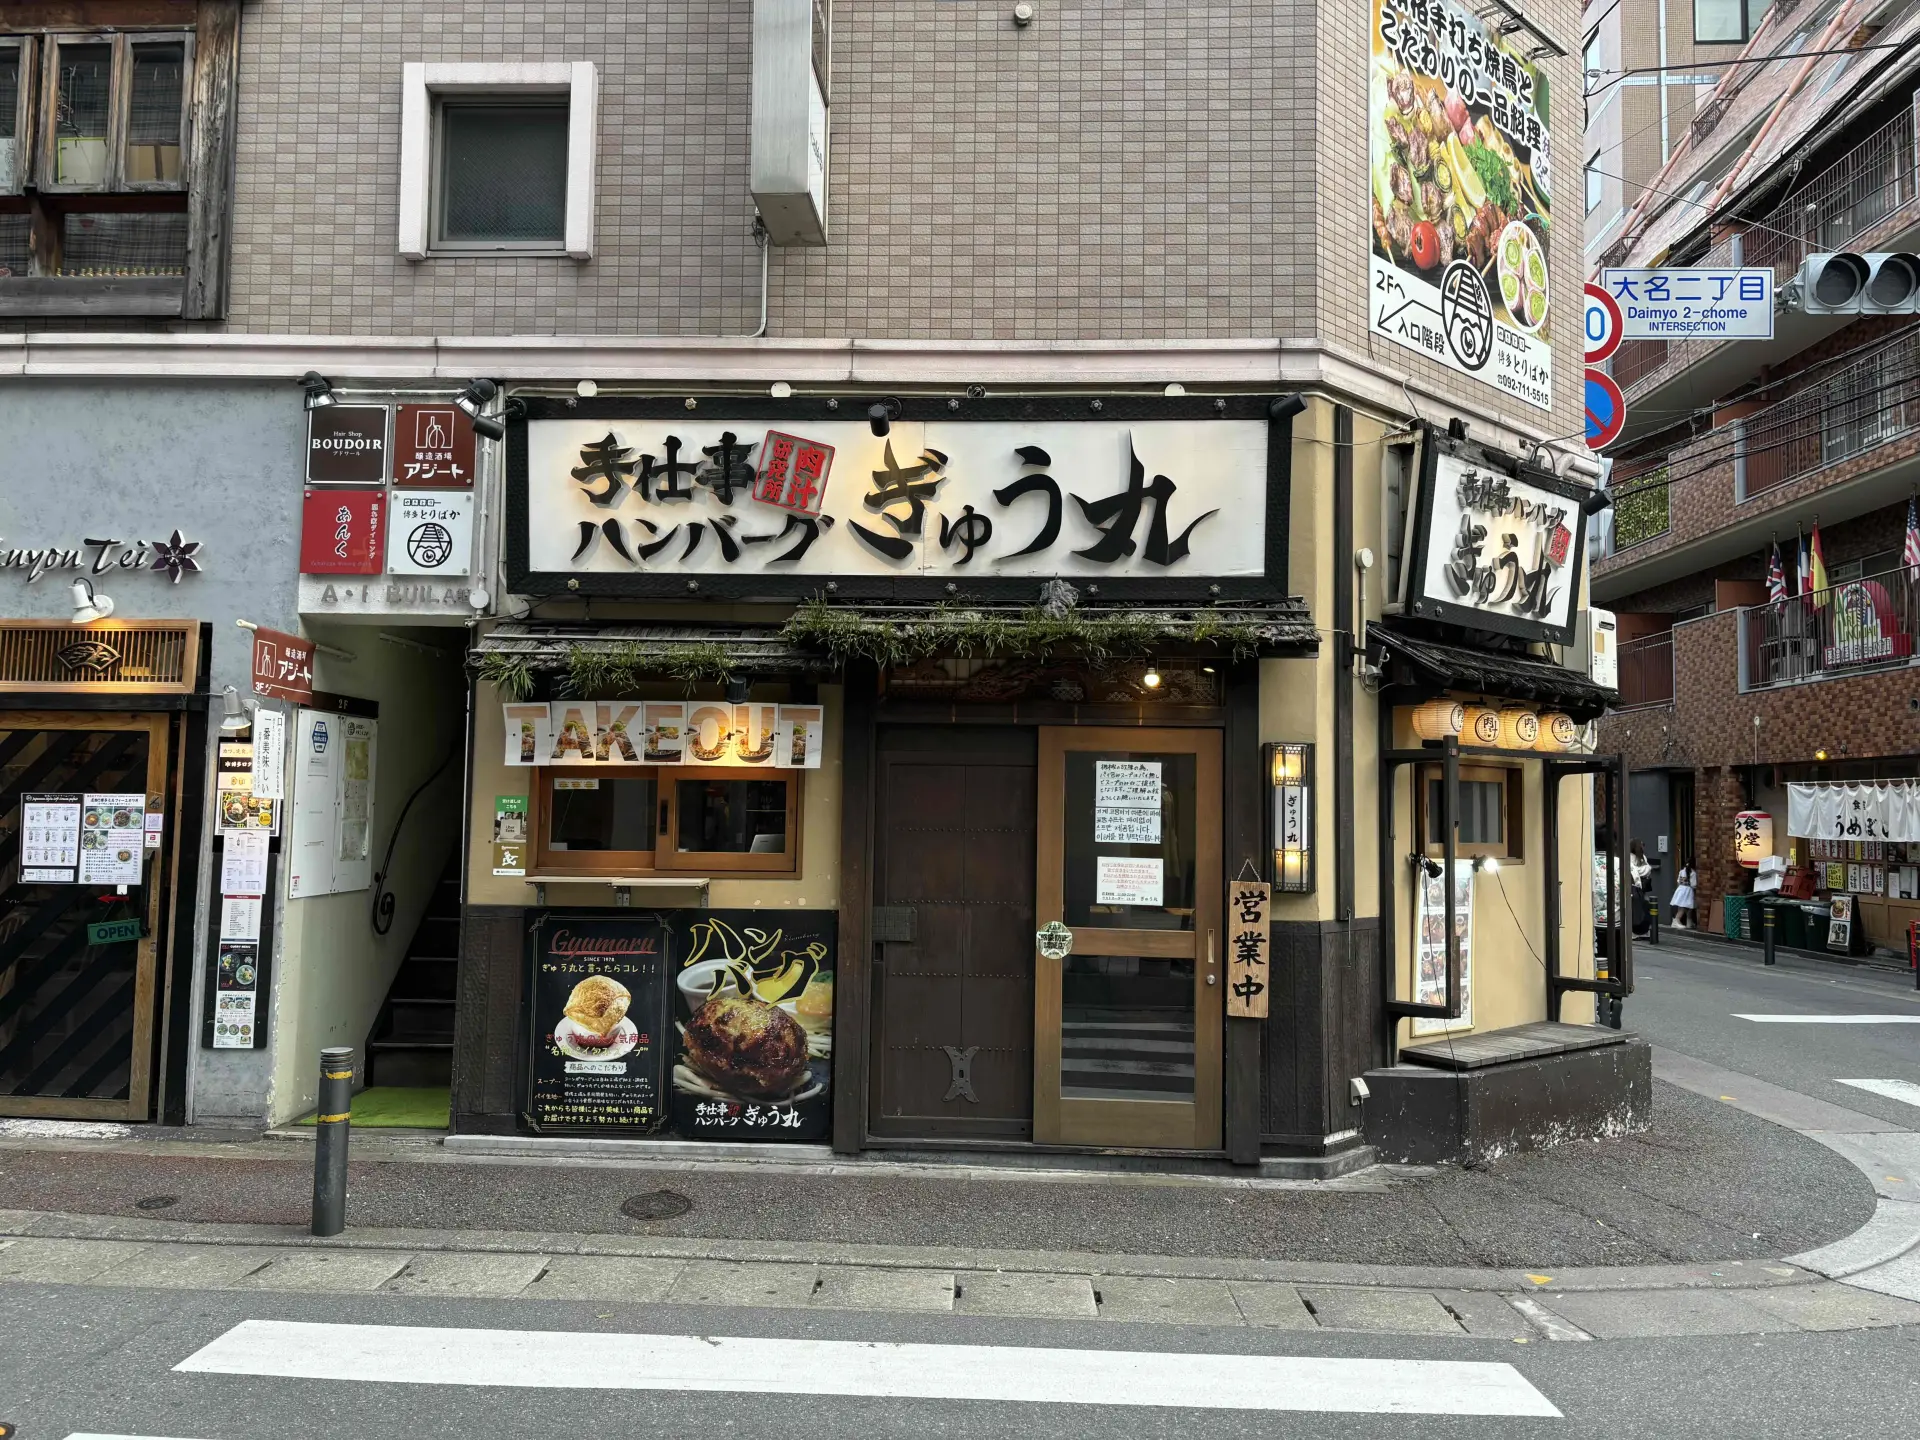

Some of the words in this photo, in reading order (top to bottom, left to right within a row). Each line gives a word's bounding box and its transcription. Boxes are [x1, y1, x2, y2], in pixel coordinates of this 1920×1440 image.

[1381, 9, 1541, 152] こだわりの一品料理
[1376, 269, 1405, 299] 2Fへ
[1612, 276, 1764, 301] 大名二丁目
[1627, 306, 1678, 321] Daimyo
[1683, 306, 1747, 319] 2-chome
[1648, 321, 1726, 331] INTERSECTION
[1398, 316, 1445, 355] 入口階段
[1498, 348, 1549, 386] 博多とりばか
[1501, 376, 1549, 406] 092-711-5515
[312, 438, 382, 450] BOUDOIR
[348, 430, 362, 438] Shop
[403, 463, 464, 479] アジート
[415, 452, 452, 461] 醸造酒場
[570, 431, 760, 506] 手仕事
[786, 446, 826, 509] 肉汁
[847, 428, 1221, 567] ぎゅう丸
[403, 509, 461, 521] 博多とりばか
[335, 505, 352, 558] あんく
[570, 513, 835, 567] ハンバーグ
[84, 538, 150, 576] Tei
[1443, 513, 1563, 619] ぎゅう丸
[255, 681, 265, 692] 3F
[277, 660, 312, 684] アジート
[338, 699, 348, 710] 2F
[506, 704, 822, 766] TAKEOUT
[1286, 795, 1299, 843] ぎゅう丸
[1742, 815, 1761, 847] 食堂
[96, 924, 135, 940] OPEN
[551, 929, 655, 961] Gyumaru
[1232, 890, 1267, 1008] 営業中
[569, 1063, 625, 1073] 商品へのこだわり
[694, 1115, 741, 1127] ハンバーグ
[695, 1102, 729, 1116] 手仕事
[742, 1104, 807, 1128] ぎゅう丸
